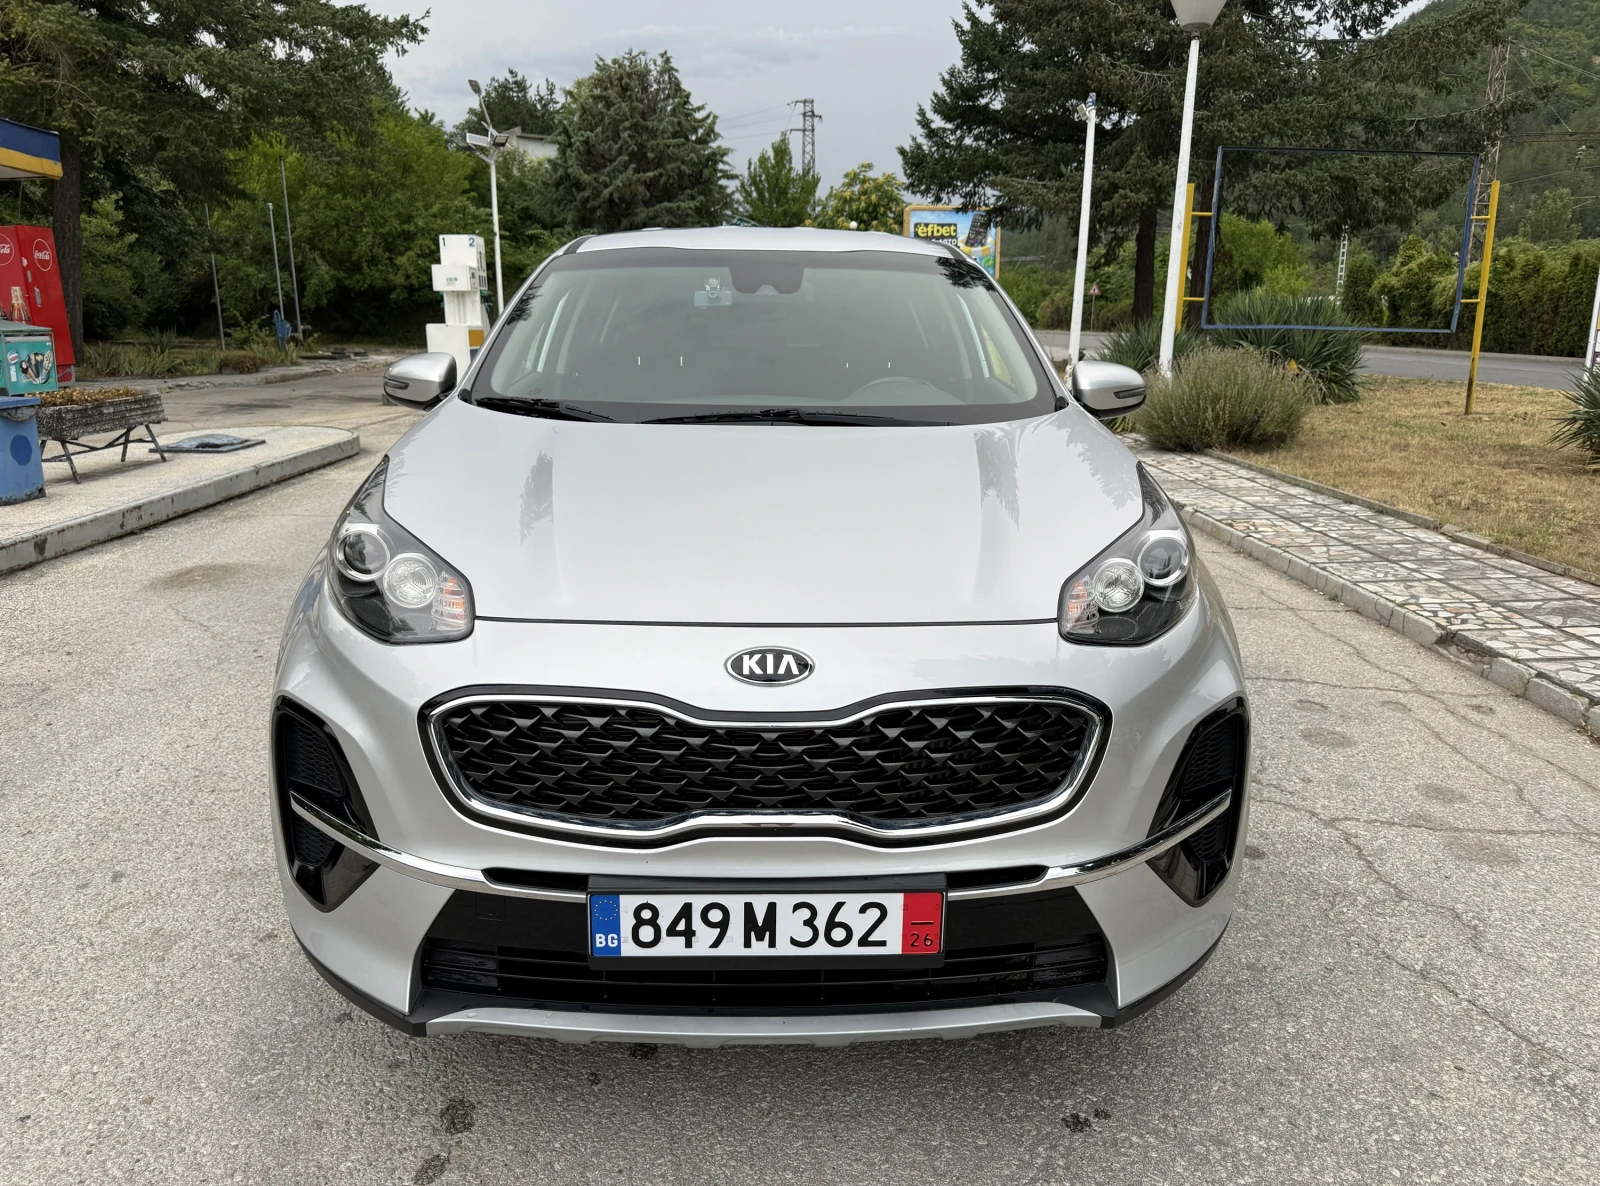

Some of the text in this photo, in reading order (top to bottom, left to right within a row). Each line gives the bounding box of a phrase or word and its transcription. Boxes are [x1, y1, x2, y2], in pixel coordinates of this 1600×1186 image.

[917, 223, 956, 237] efbet
[442, 237, 446, 247] 1
[469, 237, 475, 247] 2
[742, 653, 800, 675] KIA
[631, 901, 888, 949] 849 M 362
[595, 933, 619, 948] BG
[910, 932, 934, 947] 26
